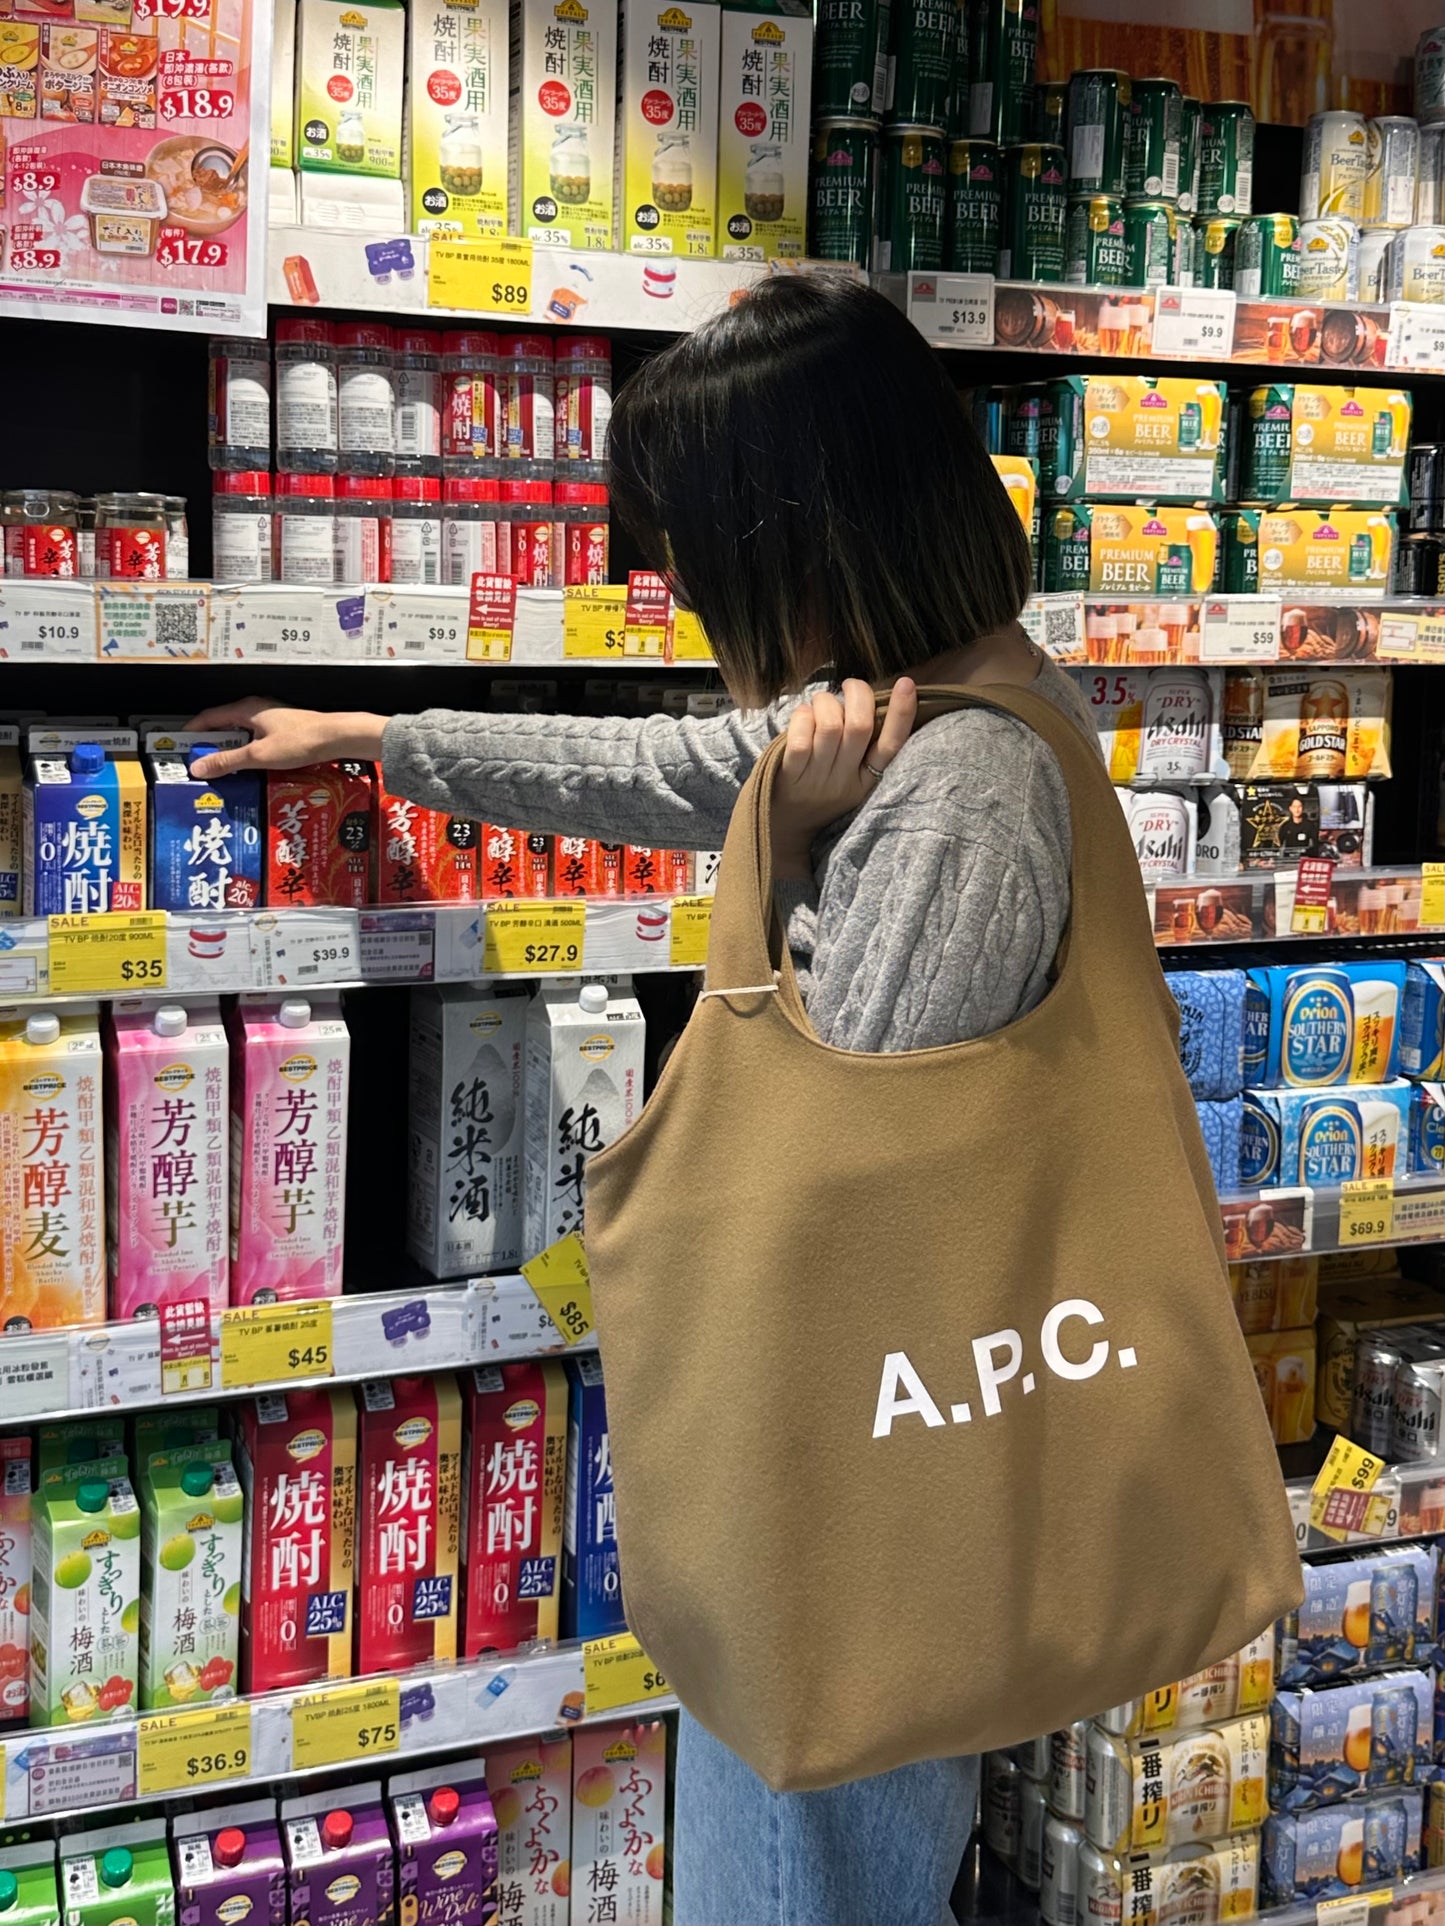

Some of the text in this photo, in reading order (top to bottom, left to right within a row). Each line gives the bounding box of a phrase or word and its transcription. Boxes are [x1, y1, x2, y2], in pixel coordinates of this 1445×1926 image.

[433, 13, 458, 64] 焼酎
[166, 52, 186, 63] 日本
[333, 32, 352, 72] 焼酎
[544, 26, 567, 76] 焼酎
[647, 35, 670, 85] 焼酎
[355, 34, 375, 111] 果実酒用
[463, 17, 487, 113] 果実酒用
[741, 48, 764, 97] 焼酎
[573, 31, 595, 123] 果実酒用
[675, 39, 698, 132] 果実酒用
[162, 90, 234, 120] $18.9
[769, 51, 791, 142] 果実酒用
[306, 126, 327, 140] お酒
[13, 173, 56, 194] $8.9
[424, 195, 448, 208] お酒
[816, 190, 865, 208] BEER
[534, 203, 557, 216] お酒
[636, 210, 658, 224] お酒
[957, 203, 999, 221] BEER
[729, 221, 751, 234] お酒
[13, 251, 56, 272] $8.9
[161, 241, 222, 269] $17.9
[491, 283, 528, 305] $89
[952, 310, 987, 325] $13.9
[1201, 326, 1224, 338] $9.9
[1134, 422, 1174, 440] BEER
[1334, 431, 1368, 446] BEER
[1099, 548, 1155, 561] PREMIUM
[1306, 554, 1344, 569] BEER
[1101, 562, 1152, 581] BEER
[567, 587, 600, 598] SALE
[38, 625, 80, 643] $10.9
[281, 628, 312, 642] $9.9
[428, 627, 457, 641] $9.9
[1252, 631, 1275, 644] $59
[1146, 711, 1206, 741] Asahi
[1308, 723, 1339, 734] SAPPORO
[1150, 737, 1201, 748] DRY CRYSTAL
[1299, 734, 1346, 752] GOLD STAR
[244, 826, 258, 845] 0
[346, 827, 365, 840] 23
[453, 823, 471, 837] 23
[1143, 820, 1173, 833] DRY
[40, 841, 56, 862] 0
[532, 836, 546, 848] 23
[62, 820, 114, 915] 焼酎
[184, 817, 234, 911] 焼酎
[115, 883, 140, 895] ALC.
[228, 886, 254, 908] 20%
[113, 894, 140, 910] 20%
[486, 904, 520, 913] SALE
[50, 917, 90, 929] SALE
[64, 931, 156, 944] TV BP 900ML
[313, 946, 350, 962] $39.9
[525, 944, 579, 964] $27.9
[121, 959, 163, 981] $35
[470, 1020, 503, 1028] BESTPRICE
[1289, 1020, 1348, 1038] SOUTHERN
[579, 1043, 616, 1052] BESTPRICE
[1291, 1036, 1342, 1056] STAR
[154, 1073, 195, 1083] BESTPRICE
[279, 1064, 318, 1073] BESTPRICE
[23, 1081, 68, 1091] BESTPRICE
[204, 1066, 223, 1252] 焼酎甲類乙類混和芋焼酎
[323, 1058, 344, 1240] 焼酎甲類乙類混和芋焼酎
[445, 1077, 495, 1223] 純米酒
[1305, 1141, 1356, 1158] SOUTHERN
[76, 1075, 96, 1267] 焼酎甲類乙類混和麦焼酎
[272, 1088, 318, 1236] 芳醇芋
[1307, 1156, 1352, 1174] STAR
[150, 1098, 198, 1249] 芳醇芋
[22, 1108, 73, 1262] 芳醇麦
[1342, 1182, 1368, 1192] SALE
[1350, 1221, 1385, 1238] $69.9
[223, 1309, 260, 1324] SALE
[560, 1300, 590, 1336] $85
[239, 1327, 264, 1337] TV BP
[288, 1345, 328, 1368] $45
[872, 1298, 1138, 1439] A.P.C.
[1351, 1457, 1376, 1490] $99
[486, 1438, 539, 1555] 焼酎
[378, 1457, 432, 1575] 焼酎
[270, 1470, 326, 1591] 焼酎
[199, 1534, 227, 1599] すっきり
[522, 1556, 554, 1574] ALC.
[96, 1550, 125, 1616] すっきり
[416, 1576, 449, 1594] ALC.
[520, 1575, 552, 1596] 25%
[604, 1571, 618, 1591] 0
[310, 1592, 343, 1610] ALC.
[493, 1583, 509, 1604] 0
[388, 1604, 404, 1625] 0
[414, 1594, 448, 1615] 25%
[172, 1606, 199, 1657] 梅酒
[281, 1620, 296, 1642] 0
[308, 1611, 343, 1632] 25%
[68, 1626, 96, 1677] 梅酒
[584, 1639, 617, 1655] SALE
[140, 1717, 178, 1732] SALE
[358, 1724, 396, 1748] $75
[187, 1749, 247, 1778] $36.9
[1138, 1739, 1164, 1830] 一番搾り
[619, 1766, 654, 1877] ふくよかな
[524, 1785, 560, 1894] ふくよかな
[586, 1858, 621, 1924] 梅酒
[420, 1891, 480, 1920] Wine Deli
